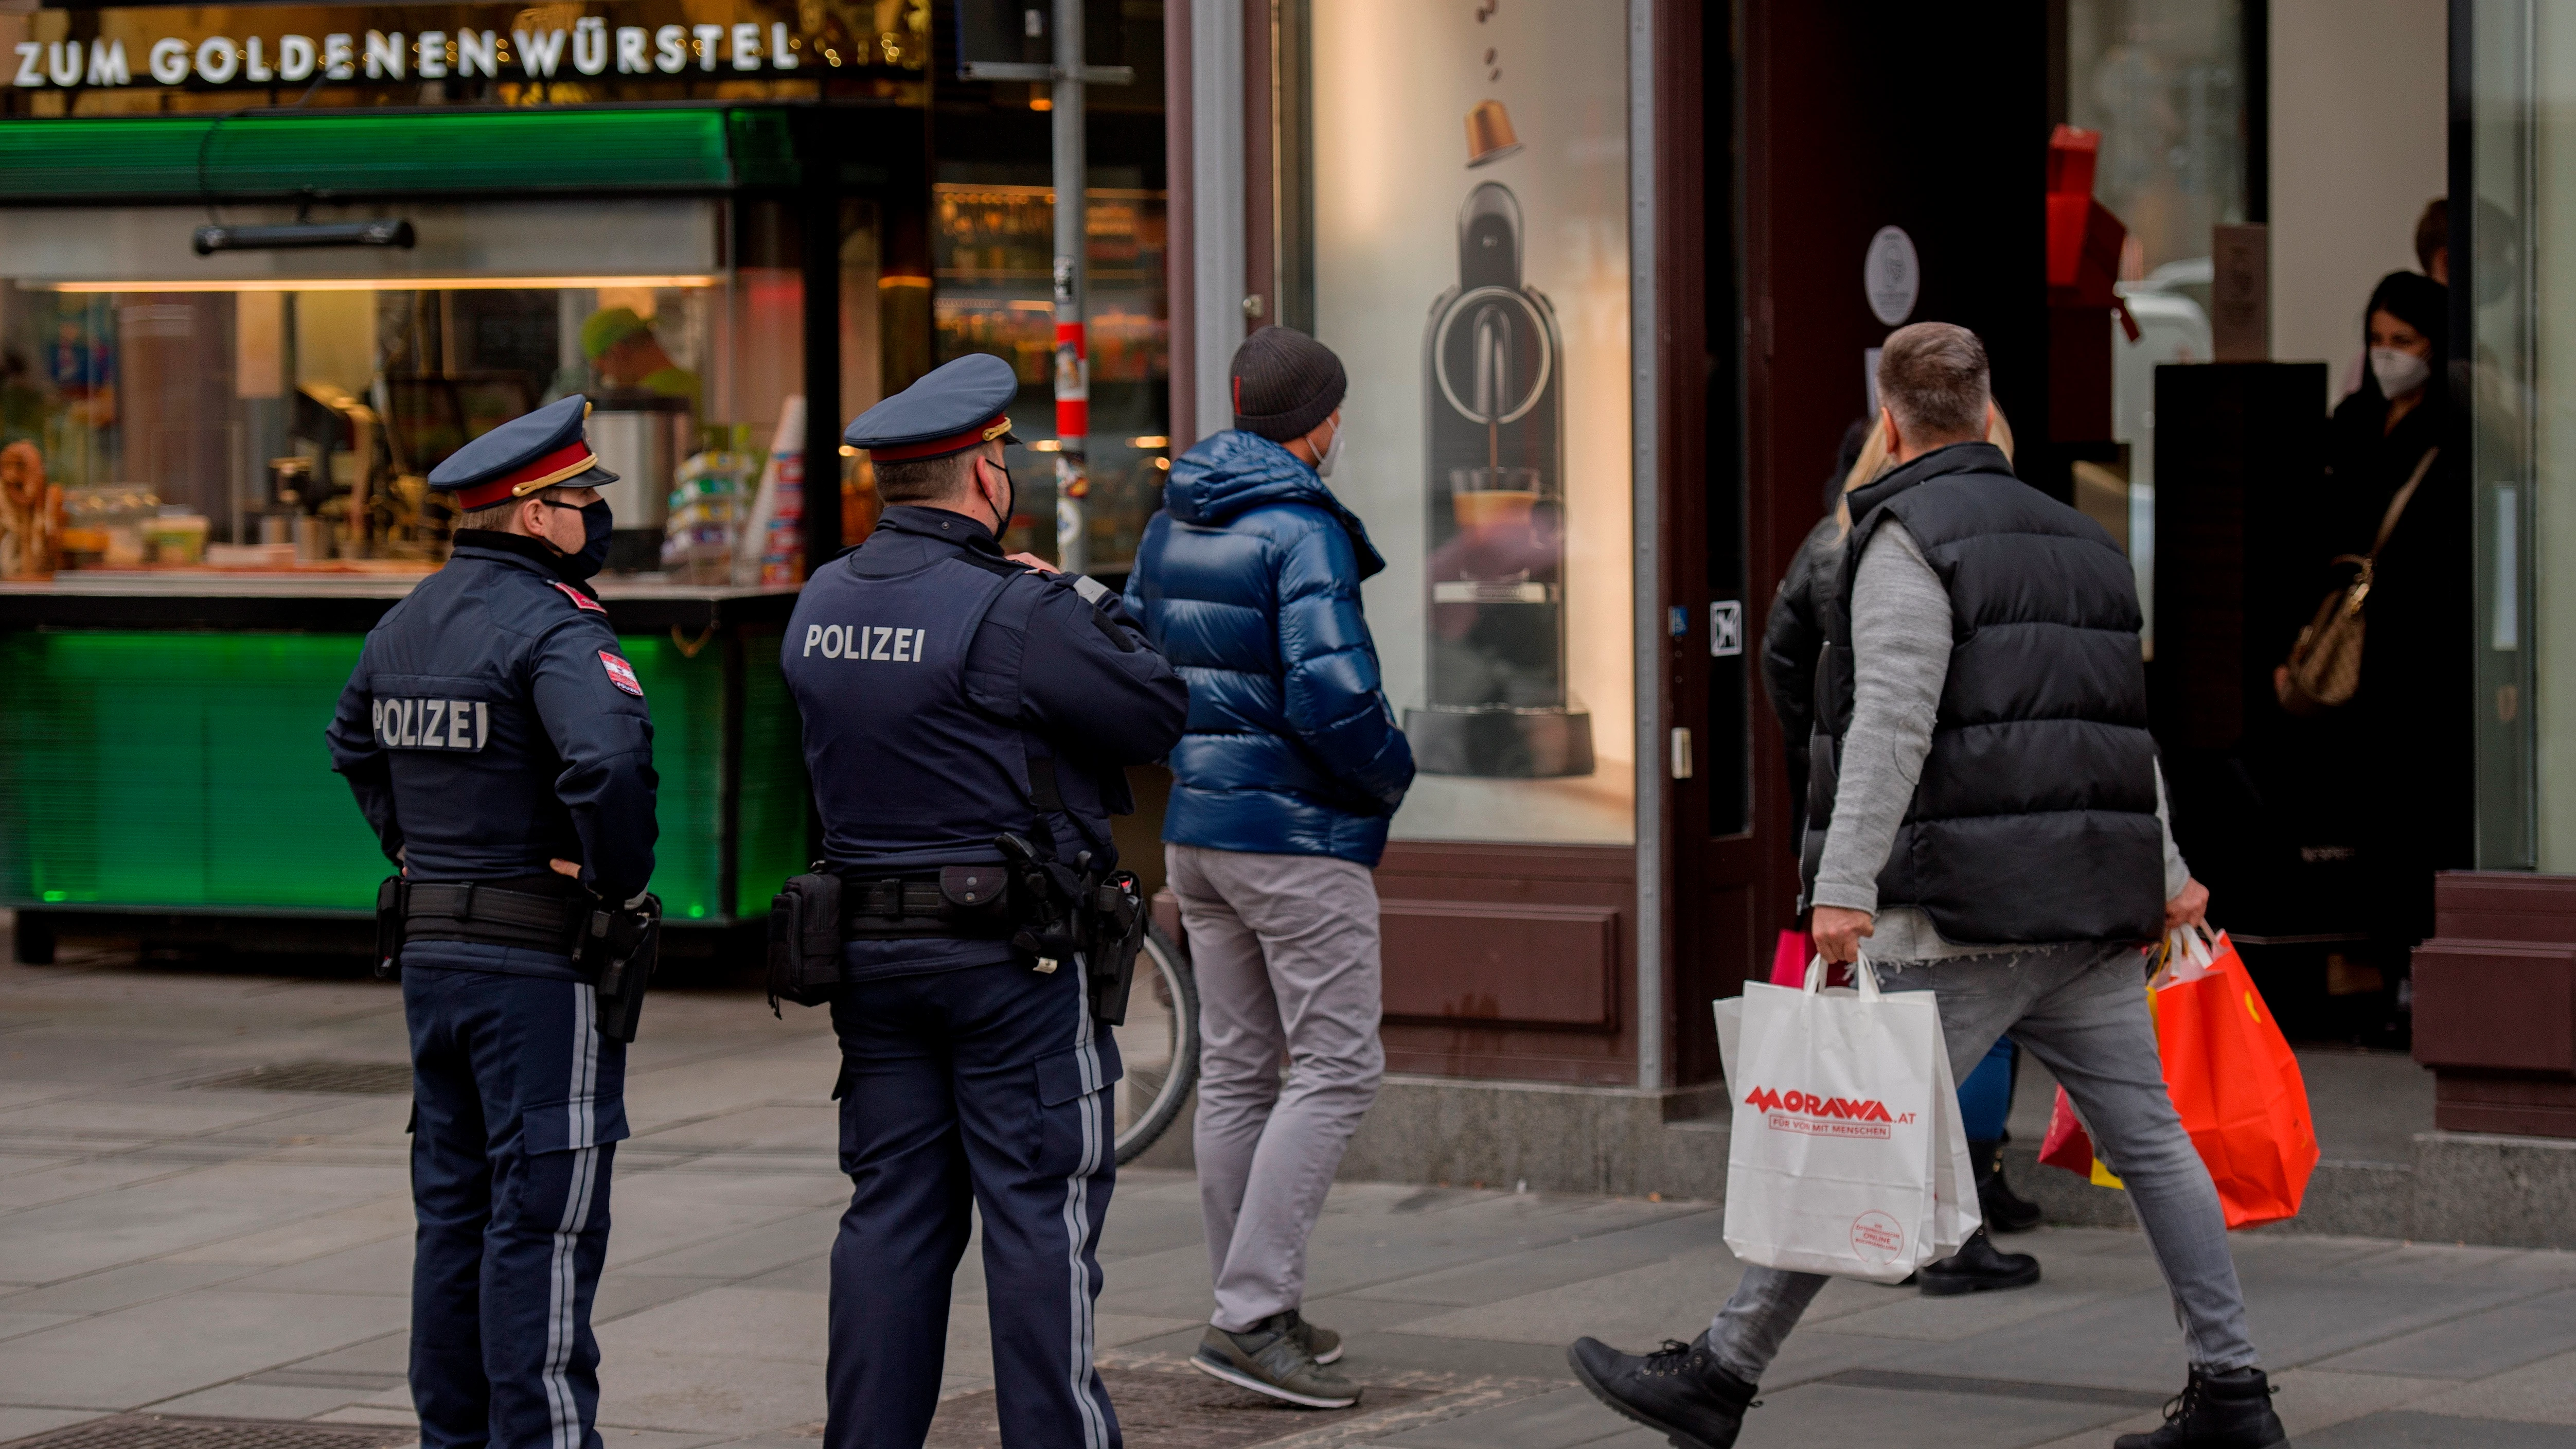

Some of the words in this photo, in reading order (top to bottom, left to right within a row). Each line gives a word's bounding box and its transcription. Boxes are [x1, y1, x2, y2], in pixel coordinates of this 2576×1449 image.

[13, 37, 132, 87] ZUM
[149, 28, 499, 85] GOLDENEN
[514, 16, 800, 78] WÜRSTEL
[803, 624, 925, 662] POLIZEI
[372, 699, 489, 748] POLIZEI
[1744, 1085, 1917, 1125] MORAWA.AT
[1773, 1116, 1790, 1129] FÜR
[1812, 1124, 1829, 1134] MIT
[1832, 1125, 1887, 1136] MENSCHEN
